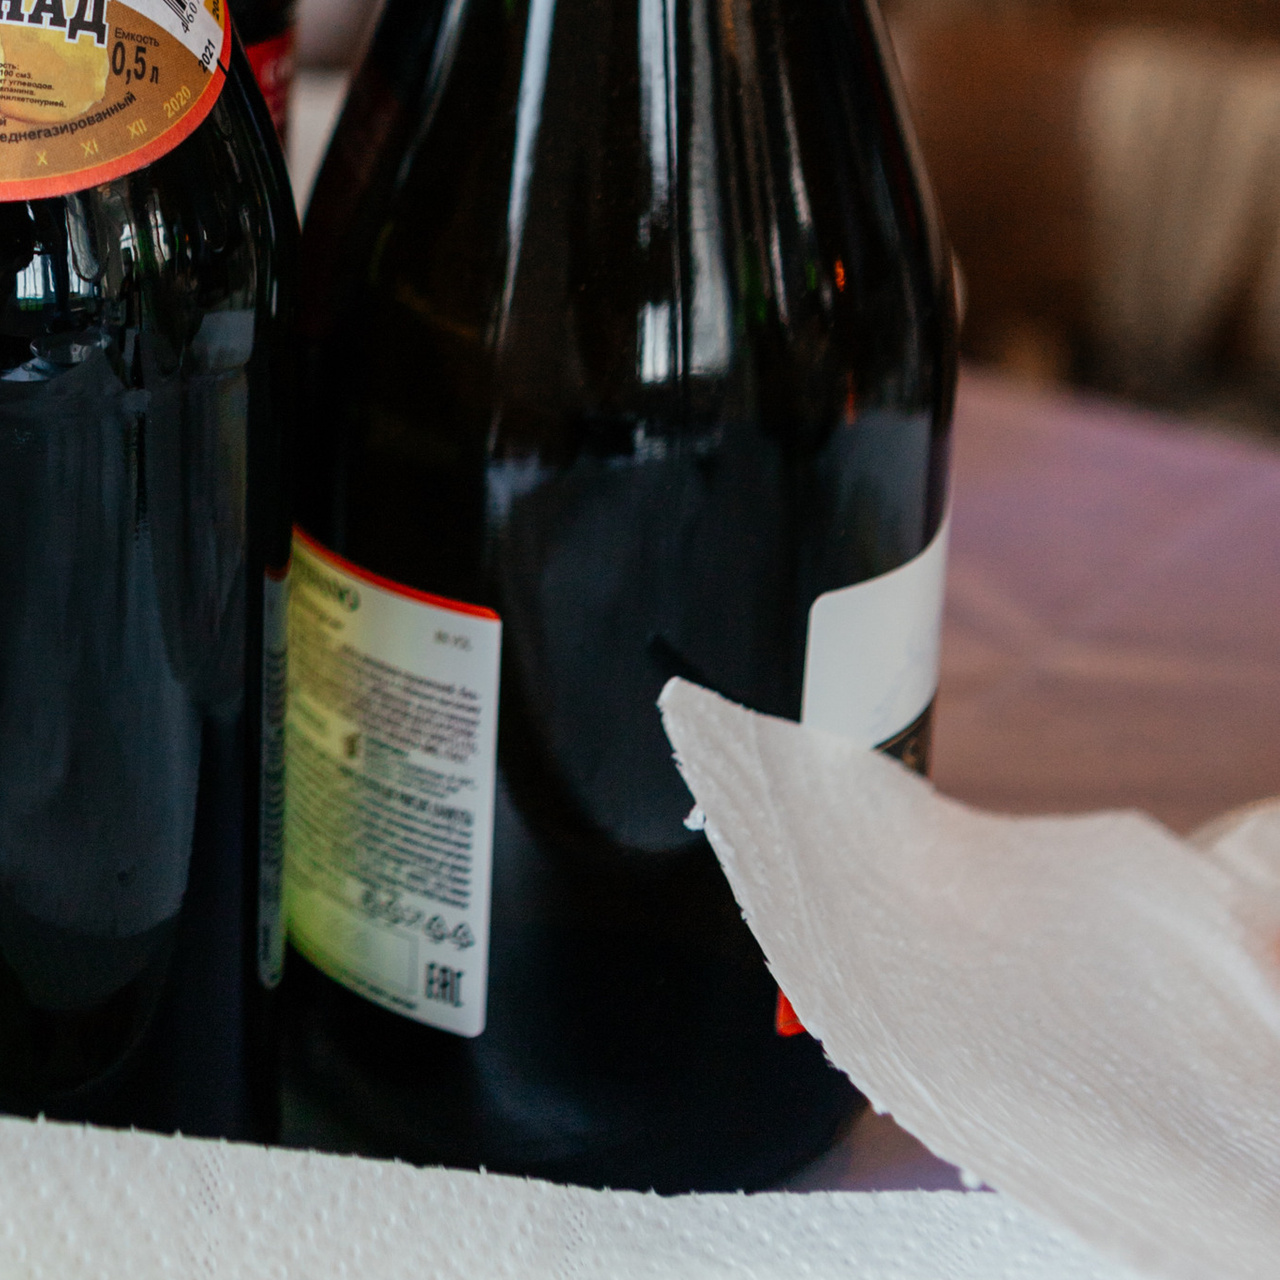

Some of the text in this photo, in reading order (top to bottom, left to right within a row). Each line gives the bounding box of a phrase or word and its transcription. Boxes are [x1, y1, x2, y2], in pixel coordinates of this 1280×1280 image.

[114, 27, 160, 48] Емкость
[111, 41, 159, 86] 0,5 л
[8, 77, 55, 91] углеводов.
[36, 150, 48, 166] X
[80, 141, 99, 158] XI
[127, 118, 148, 140] XII
[163, 85, 191, 118] 2020
[198, 38, 216, 73] 2021
